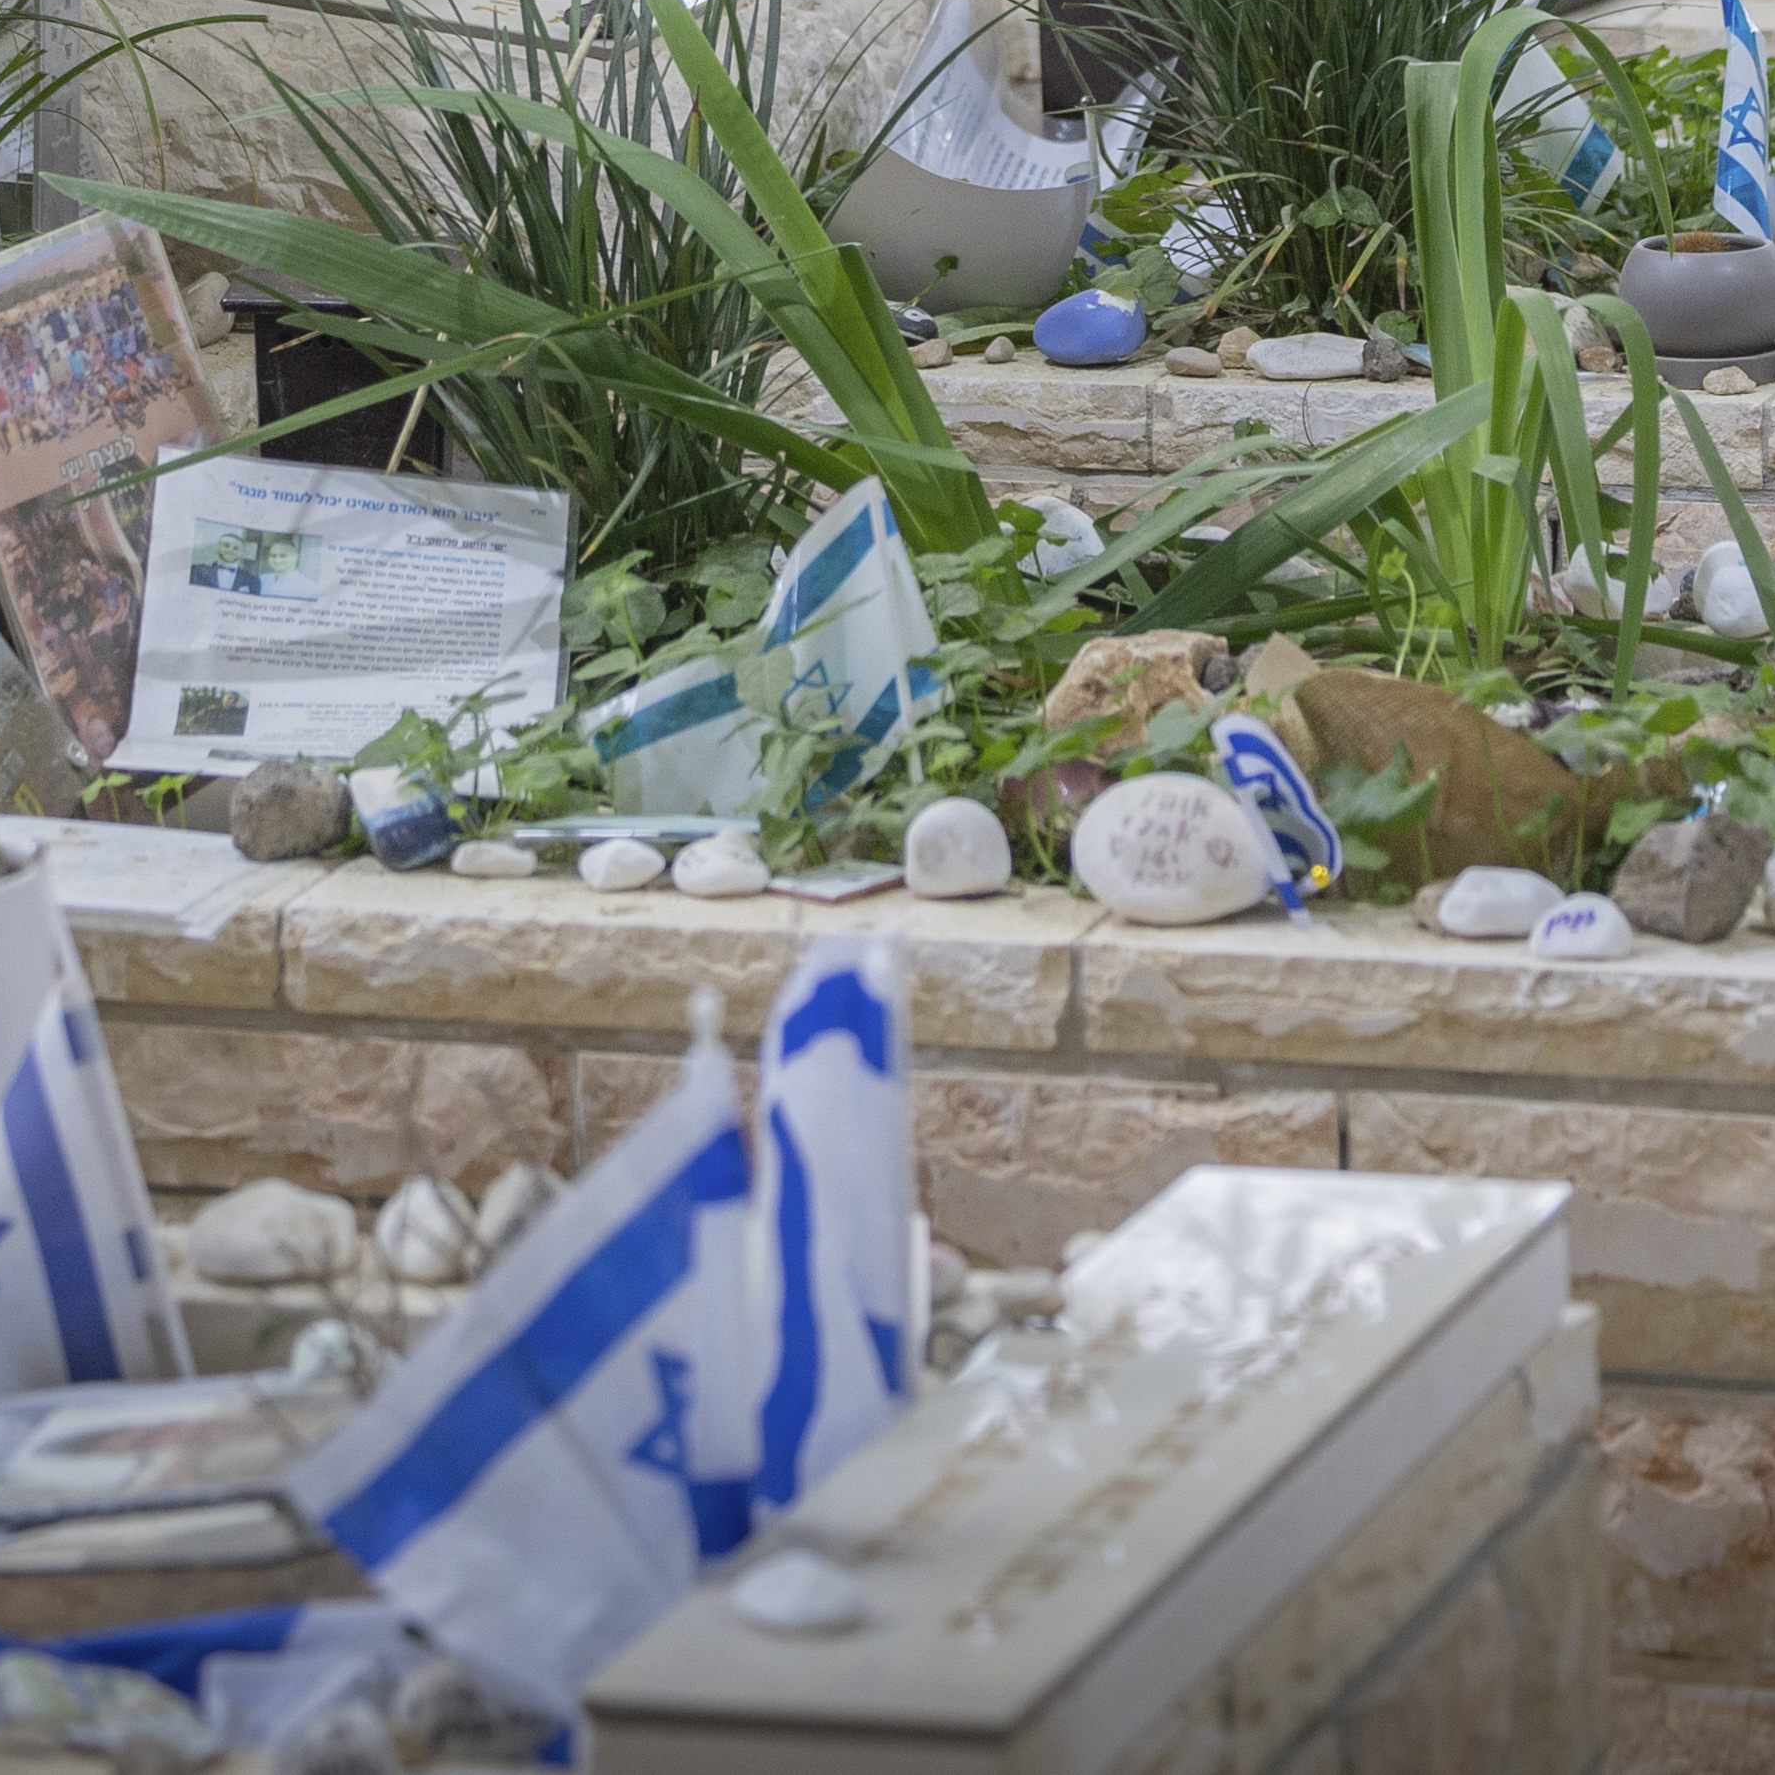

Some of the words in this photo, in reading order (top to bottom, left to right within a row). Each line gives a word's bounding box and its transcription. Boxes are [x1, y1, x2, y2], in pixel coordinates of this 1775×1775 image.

[87, 434, 136, 472] לנצח
[60, 456, 86, 481] ישי
[271, 487, 313, 505] לעמוד
[316, 493, 342, 508] יכול
[346, 499, 385, 512] שאינו
[388, 502, 427, 517] האדם
[432, 507, 457, 520] הוא
